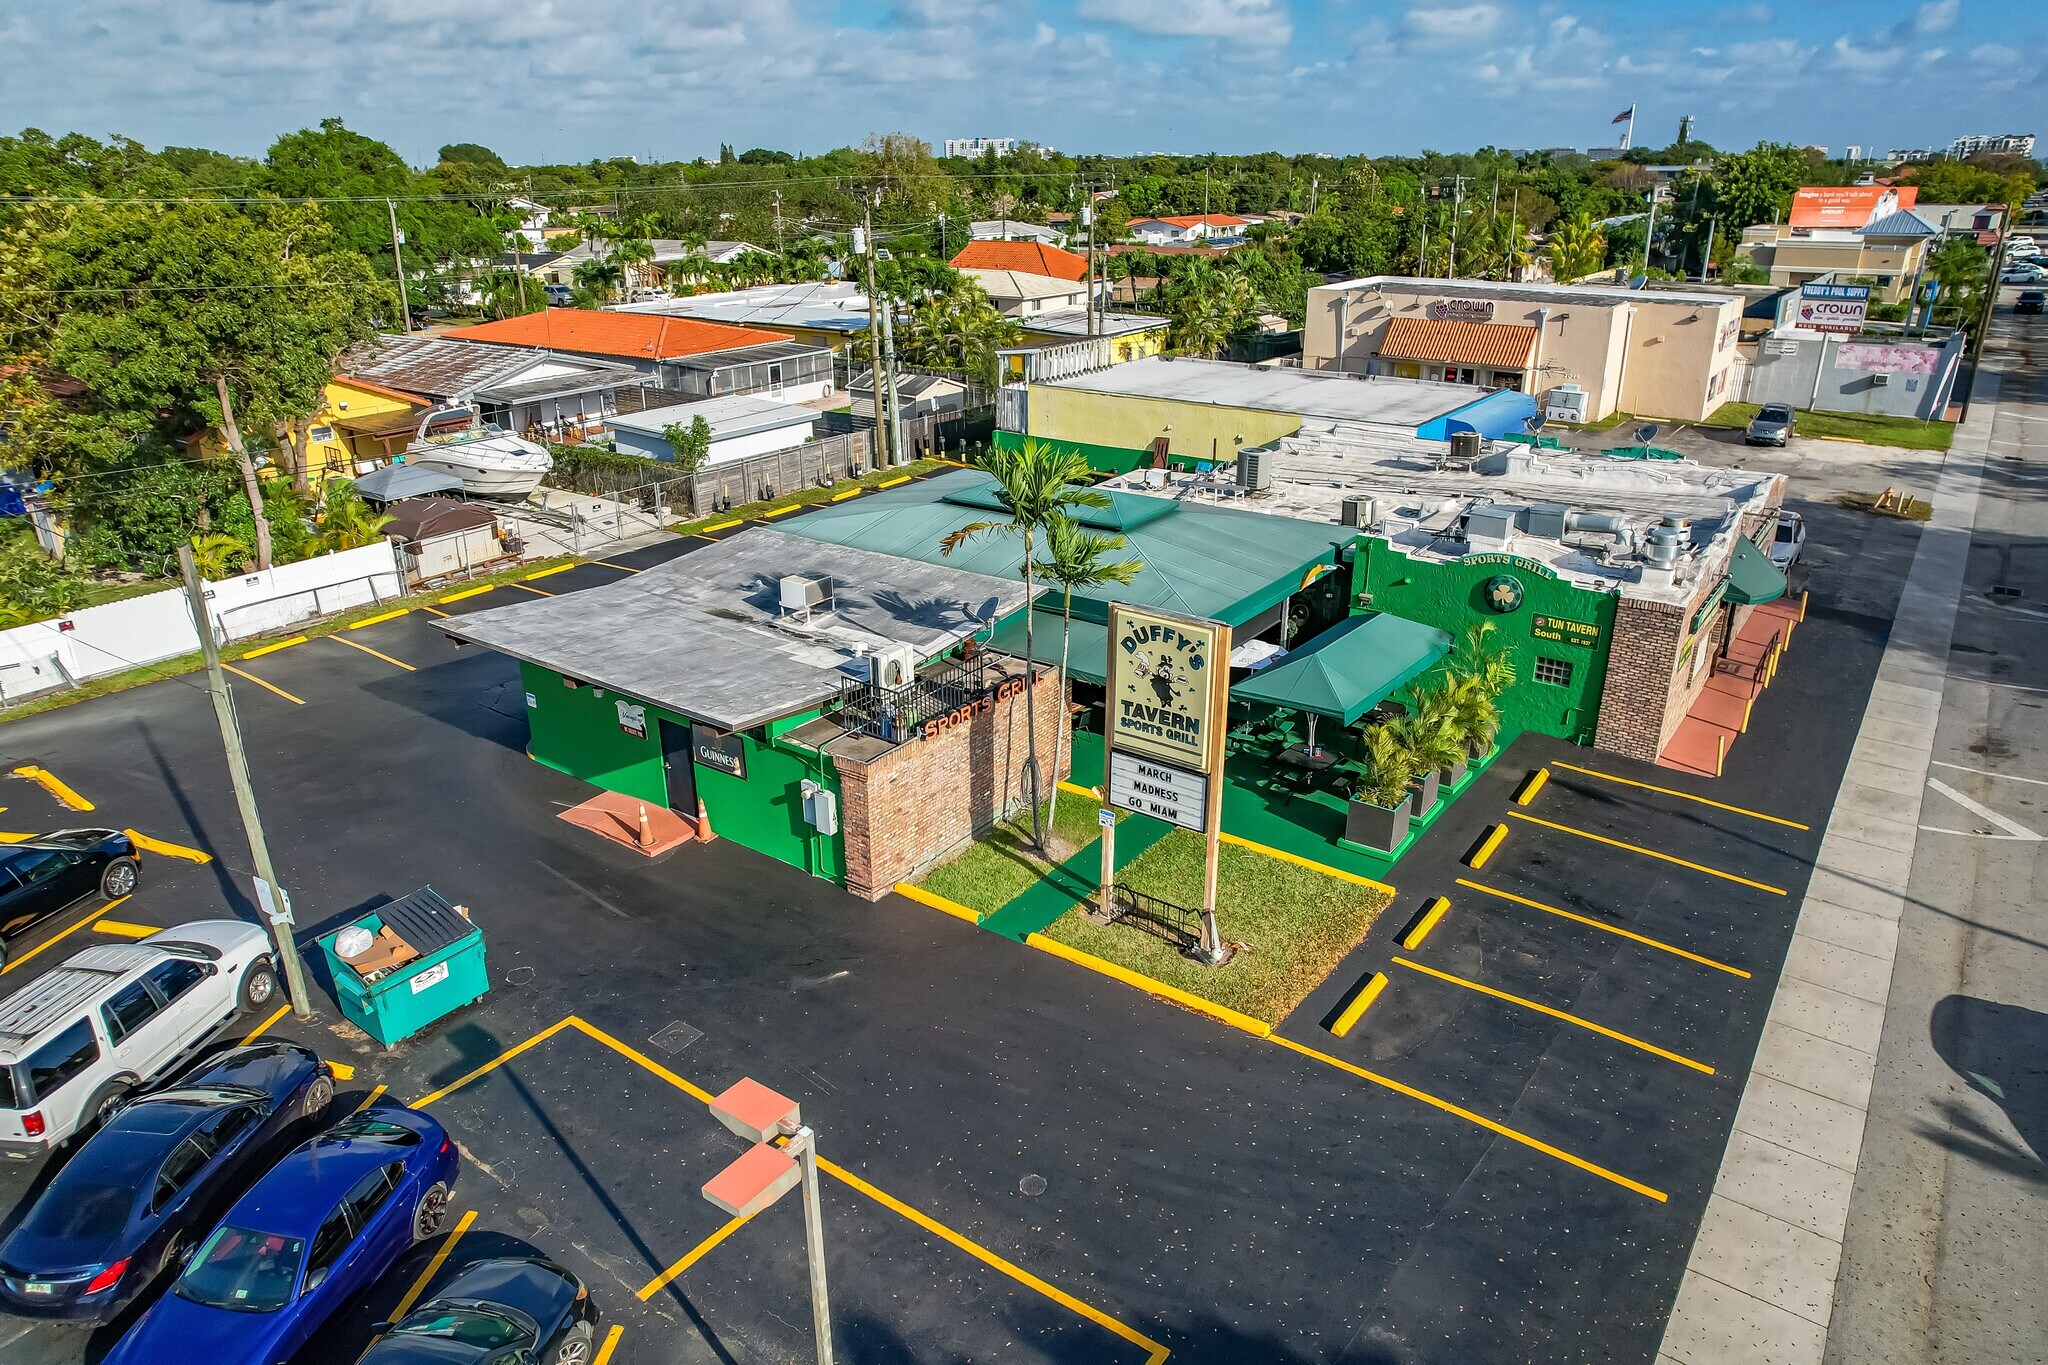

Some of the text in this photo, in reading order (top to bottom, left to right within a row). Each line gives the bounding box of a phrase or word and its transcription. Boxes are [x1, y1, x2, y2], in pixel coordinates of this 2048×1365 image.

[1803, 285, 1868, 297] FREDDY'S POOL SUPPLY
[1450, 299, 1494, 313] crown
[1816, 303, 1863, 315] crown
[1548, 411, 1577, 420] ICE
[1463, 554, 1553, 580] SPORTS GRILL
[1534, 627, 1561, 640] South
[1547, 617, 1599, 637] TUN TAVERN
[1121, 625, 1205, 671] DUFFY'S
[924, 695, 991, 741] SPORTS
[1121, 699, 1200, 735] TAVERN
[1120, 716, 1198, 747] SPORTS GRILL
[1138, 764, 1172, 783] MARCH
[1133, 780, 1179, 802] MADNESS
[1128, 796, 1178, 820] GO MIAMI
